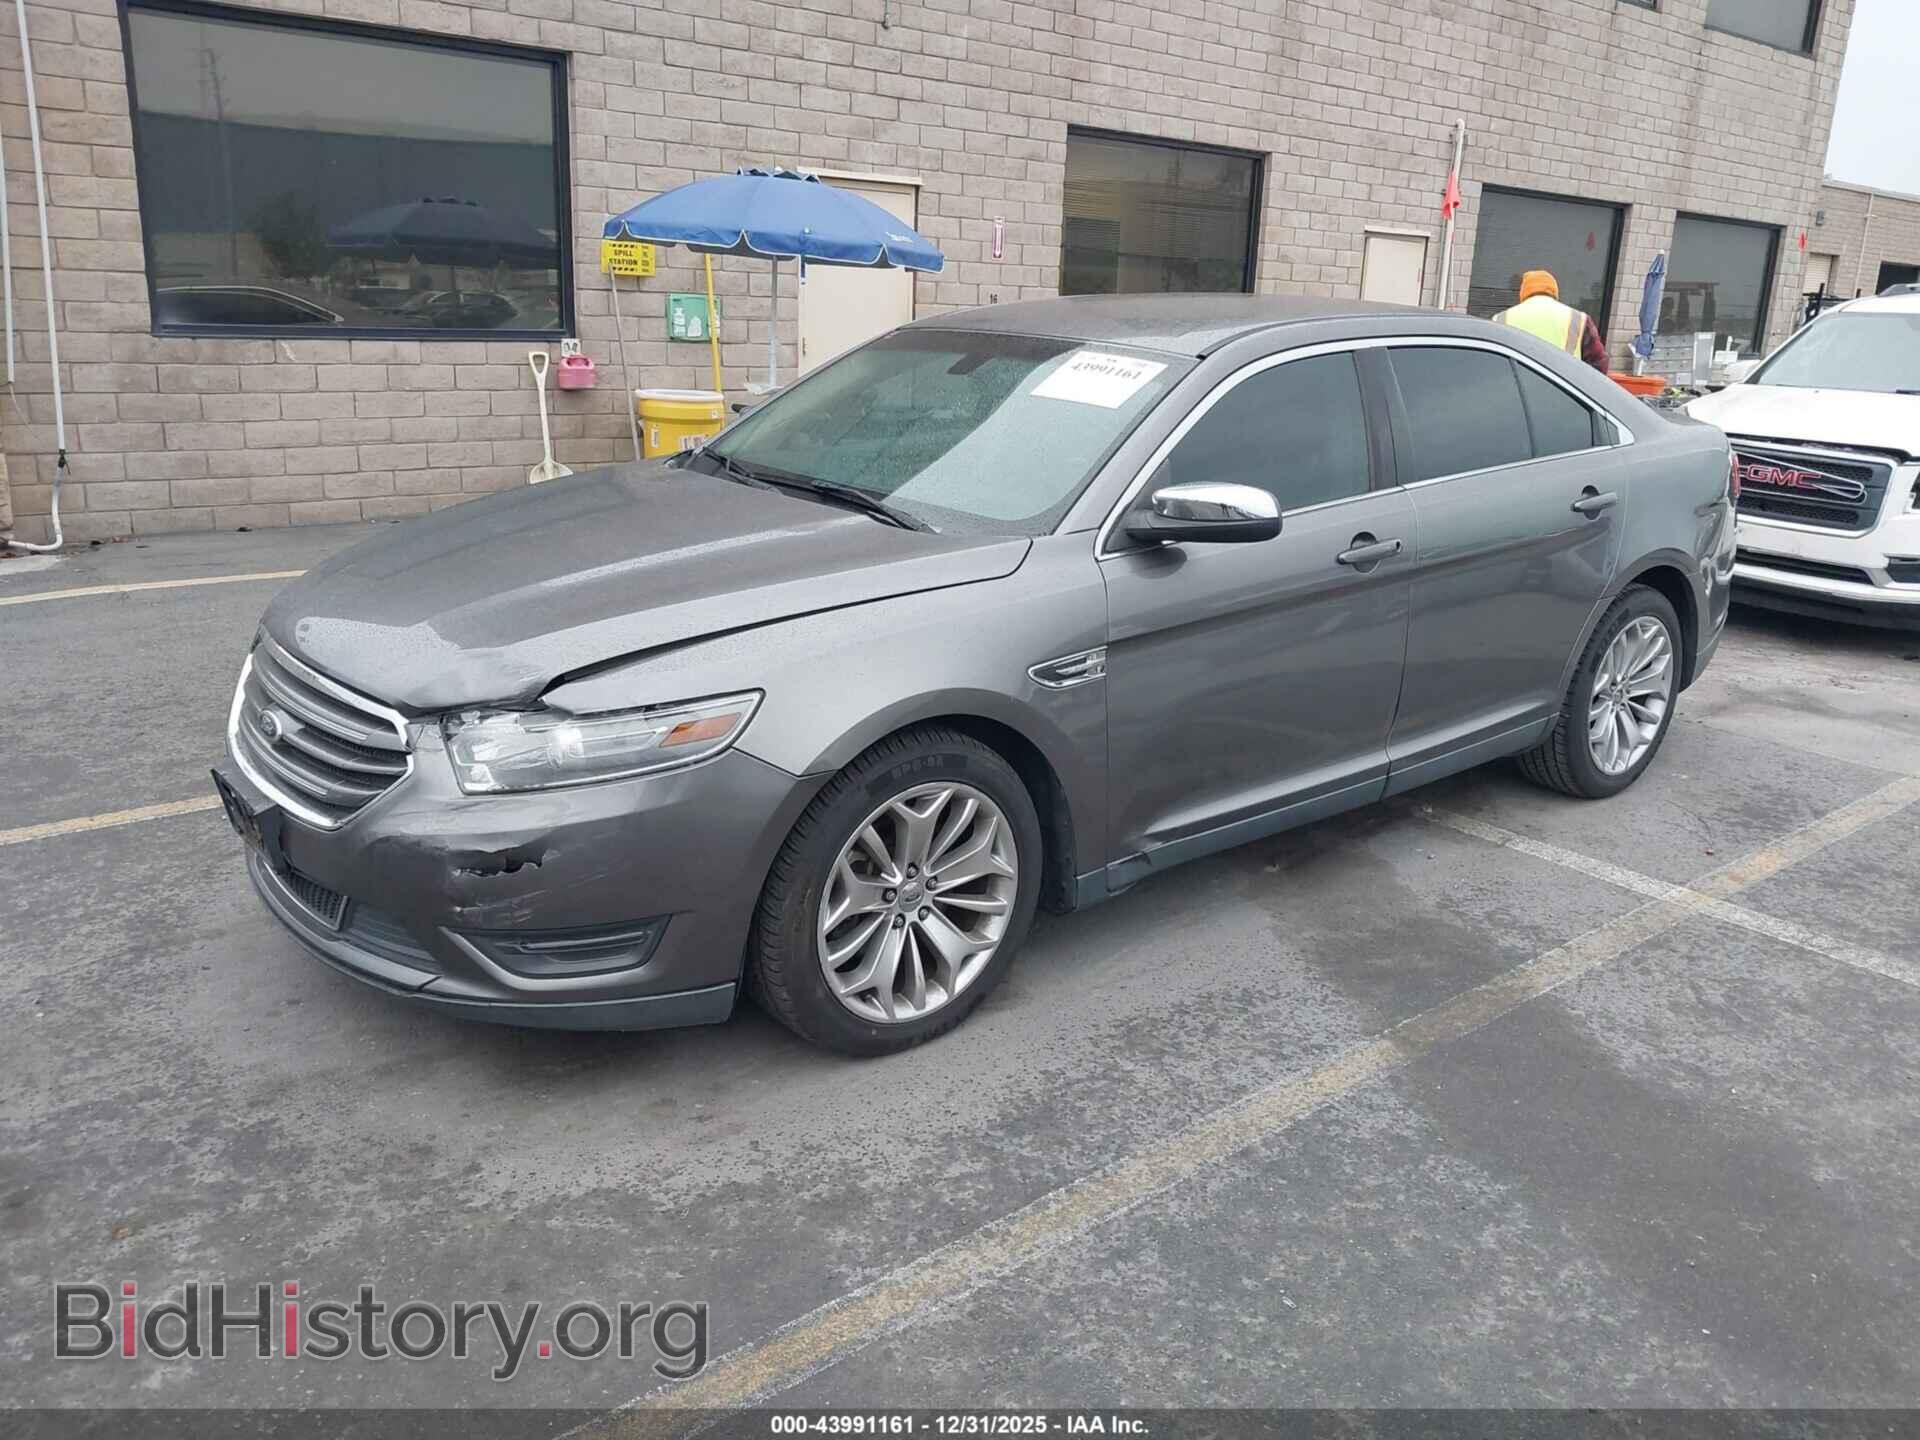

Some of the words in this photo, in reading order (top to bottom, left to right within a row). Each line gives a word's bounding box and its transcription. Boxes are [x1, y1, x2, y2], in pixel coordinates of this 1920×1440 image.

[614, 249, 633, 257] SPILL
[609, 258, 638, 266] STATION
[1745, 464, 1821, 489] GMC
